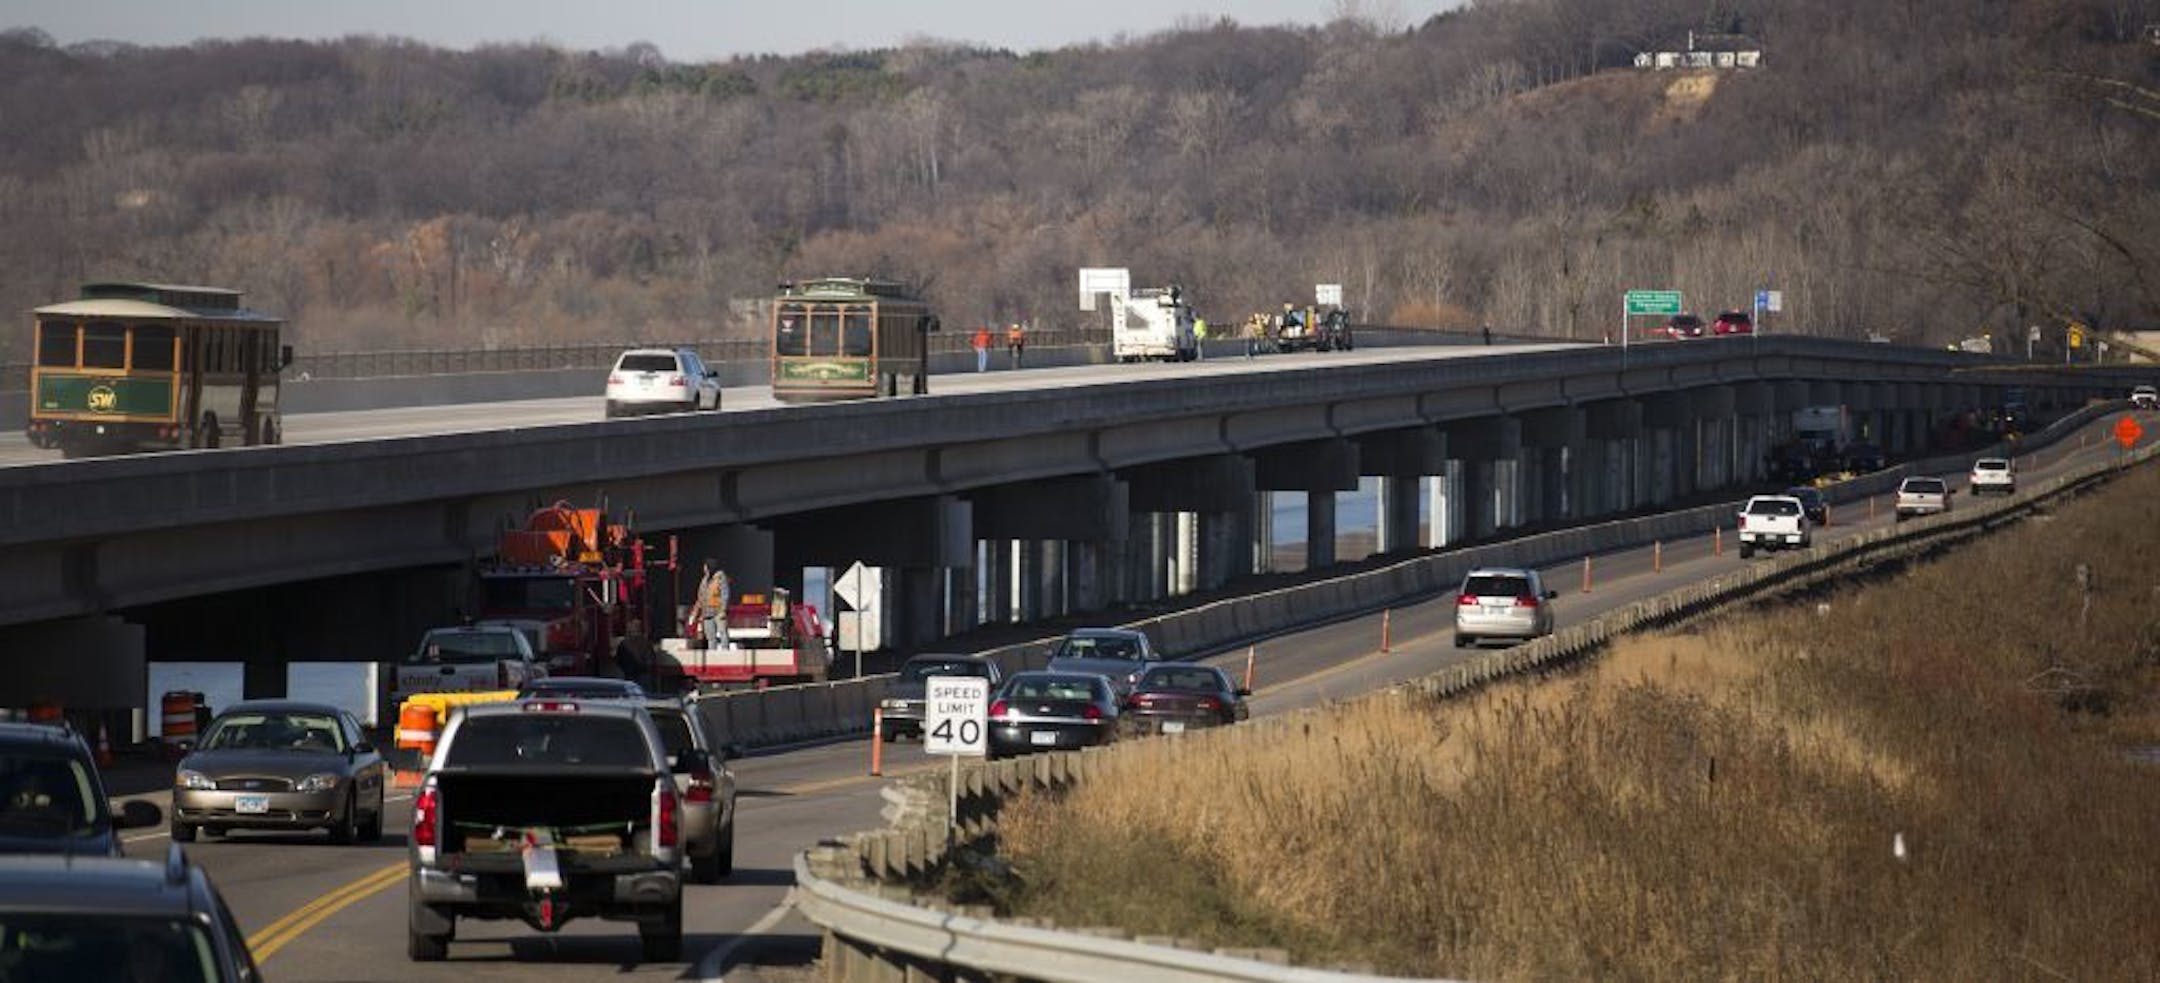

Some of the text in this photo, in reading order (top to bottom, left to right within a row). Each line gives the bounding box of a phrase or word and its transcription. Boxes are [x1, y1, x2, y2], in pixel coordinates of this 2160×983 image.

[89, 393, 114, 407] SW
[934, 688, 981, 699] SPEED
[938, 702, 975, 714] LIMIT
[931, 718, 979, 745] 40
